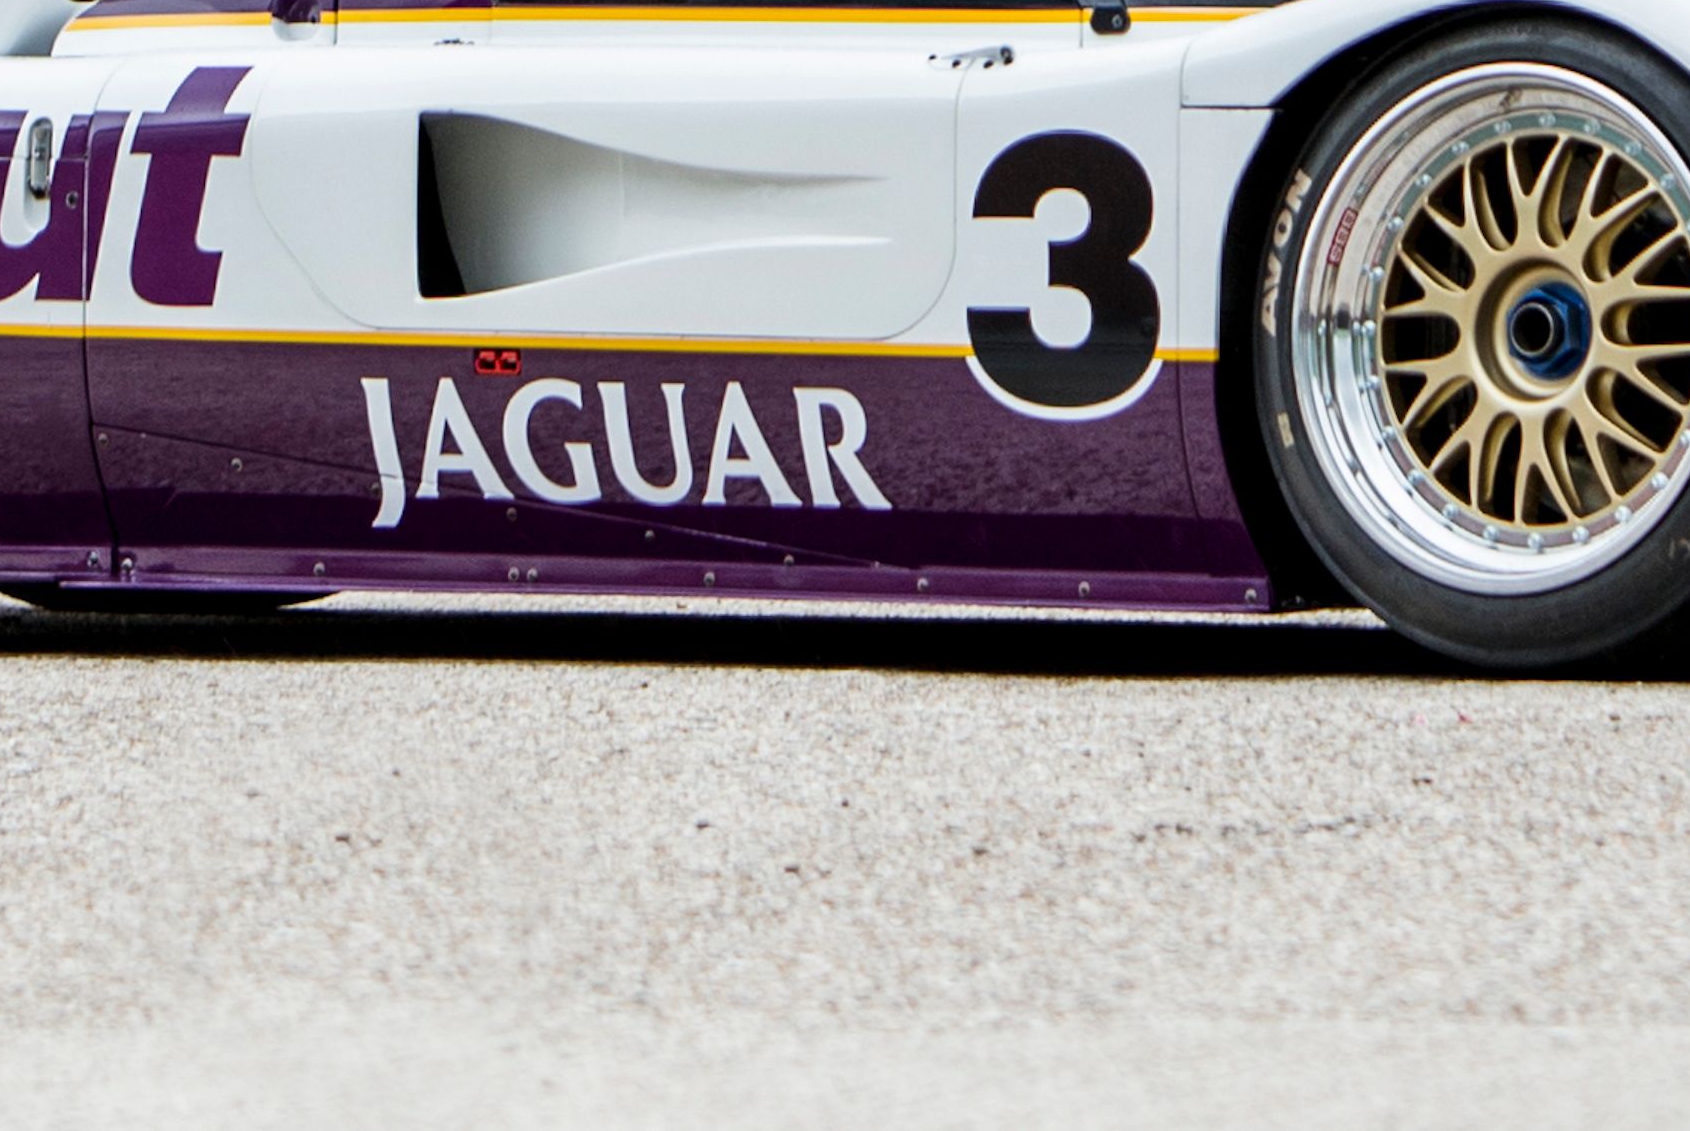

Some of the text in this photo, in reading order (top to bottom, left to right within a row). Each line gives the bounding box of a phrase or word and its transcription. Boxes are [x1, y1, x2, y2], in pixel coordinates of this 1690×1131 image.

[965, 128, 1163, 414] 3
[1261, 168, 1312, 337] AVON
[360, 377, 892, 528] JAGUAR
